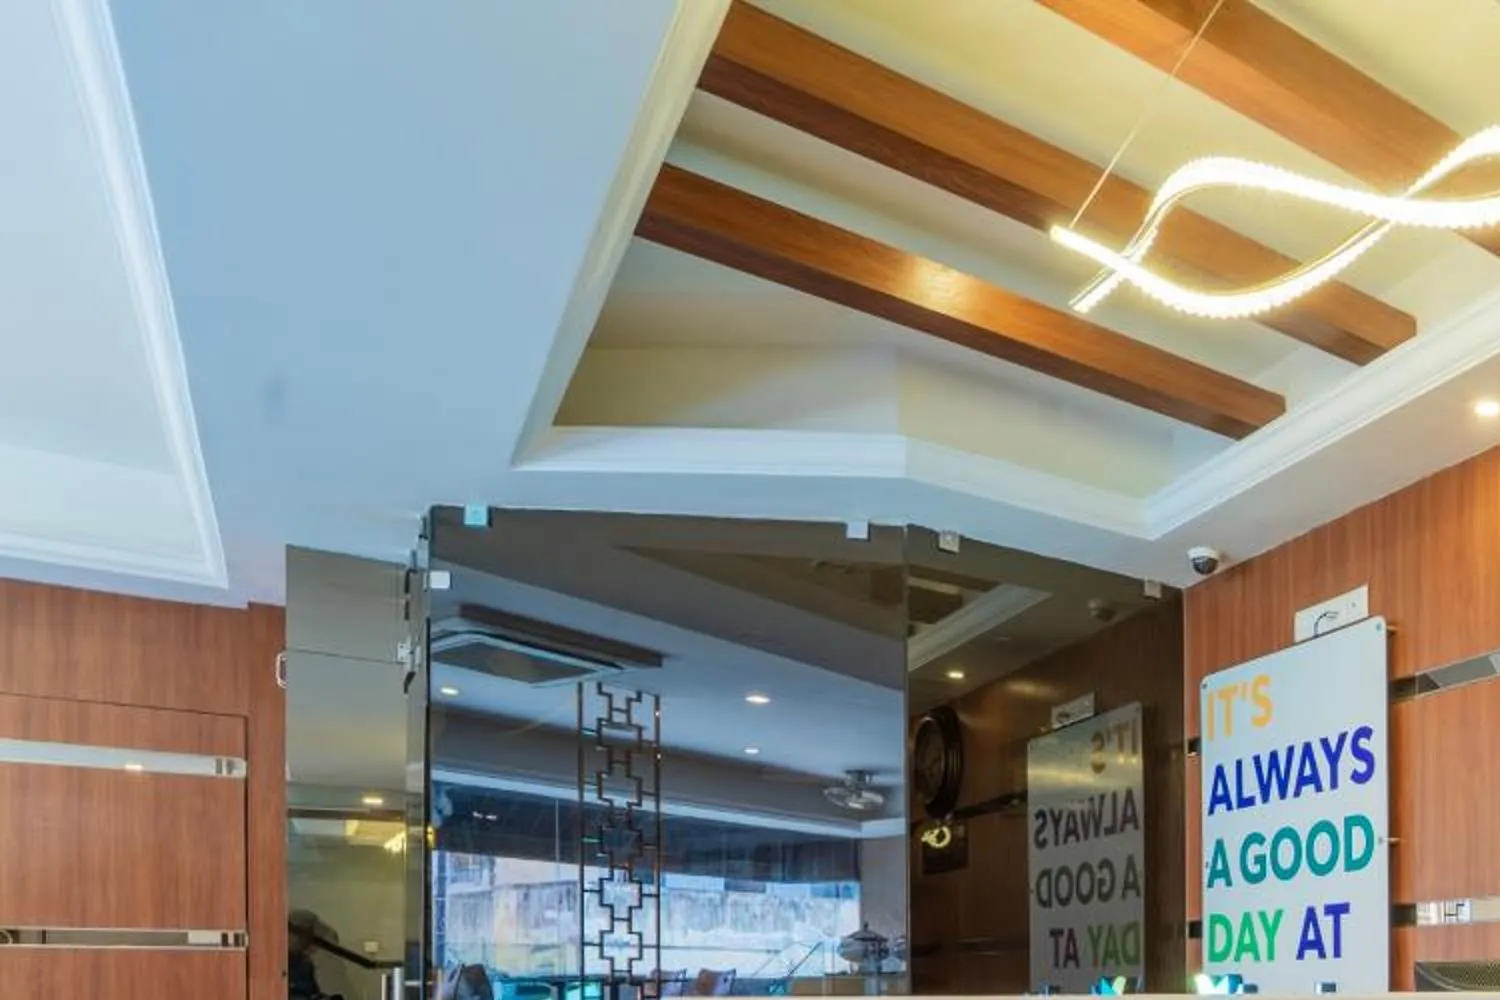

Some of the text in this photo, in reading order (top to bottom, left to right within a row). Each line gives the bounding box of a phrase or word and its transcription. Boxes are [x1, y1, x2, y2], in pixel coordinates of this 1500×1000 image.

[1208, 675, 1273, 740] IT'S
[1207, 726, 1375, 815] ALWAYS
[1207, 815, 1374, 888] A GOOD
[1208, 902, 1350, 962] DAY AT
